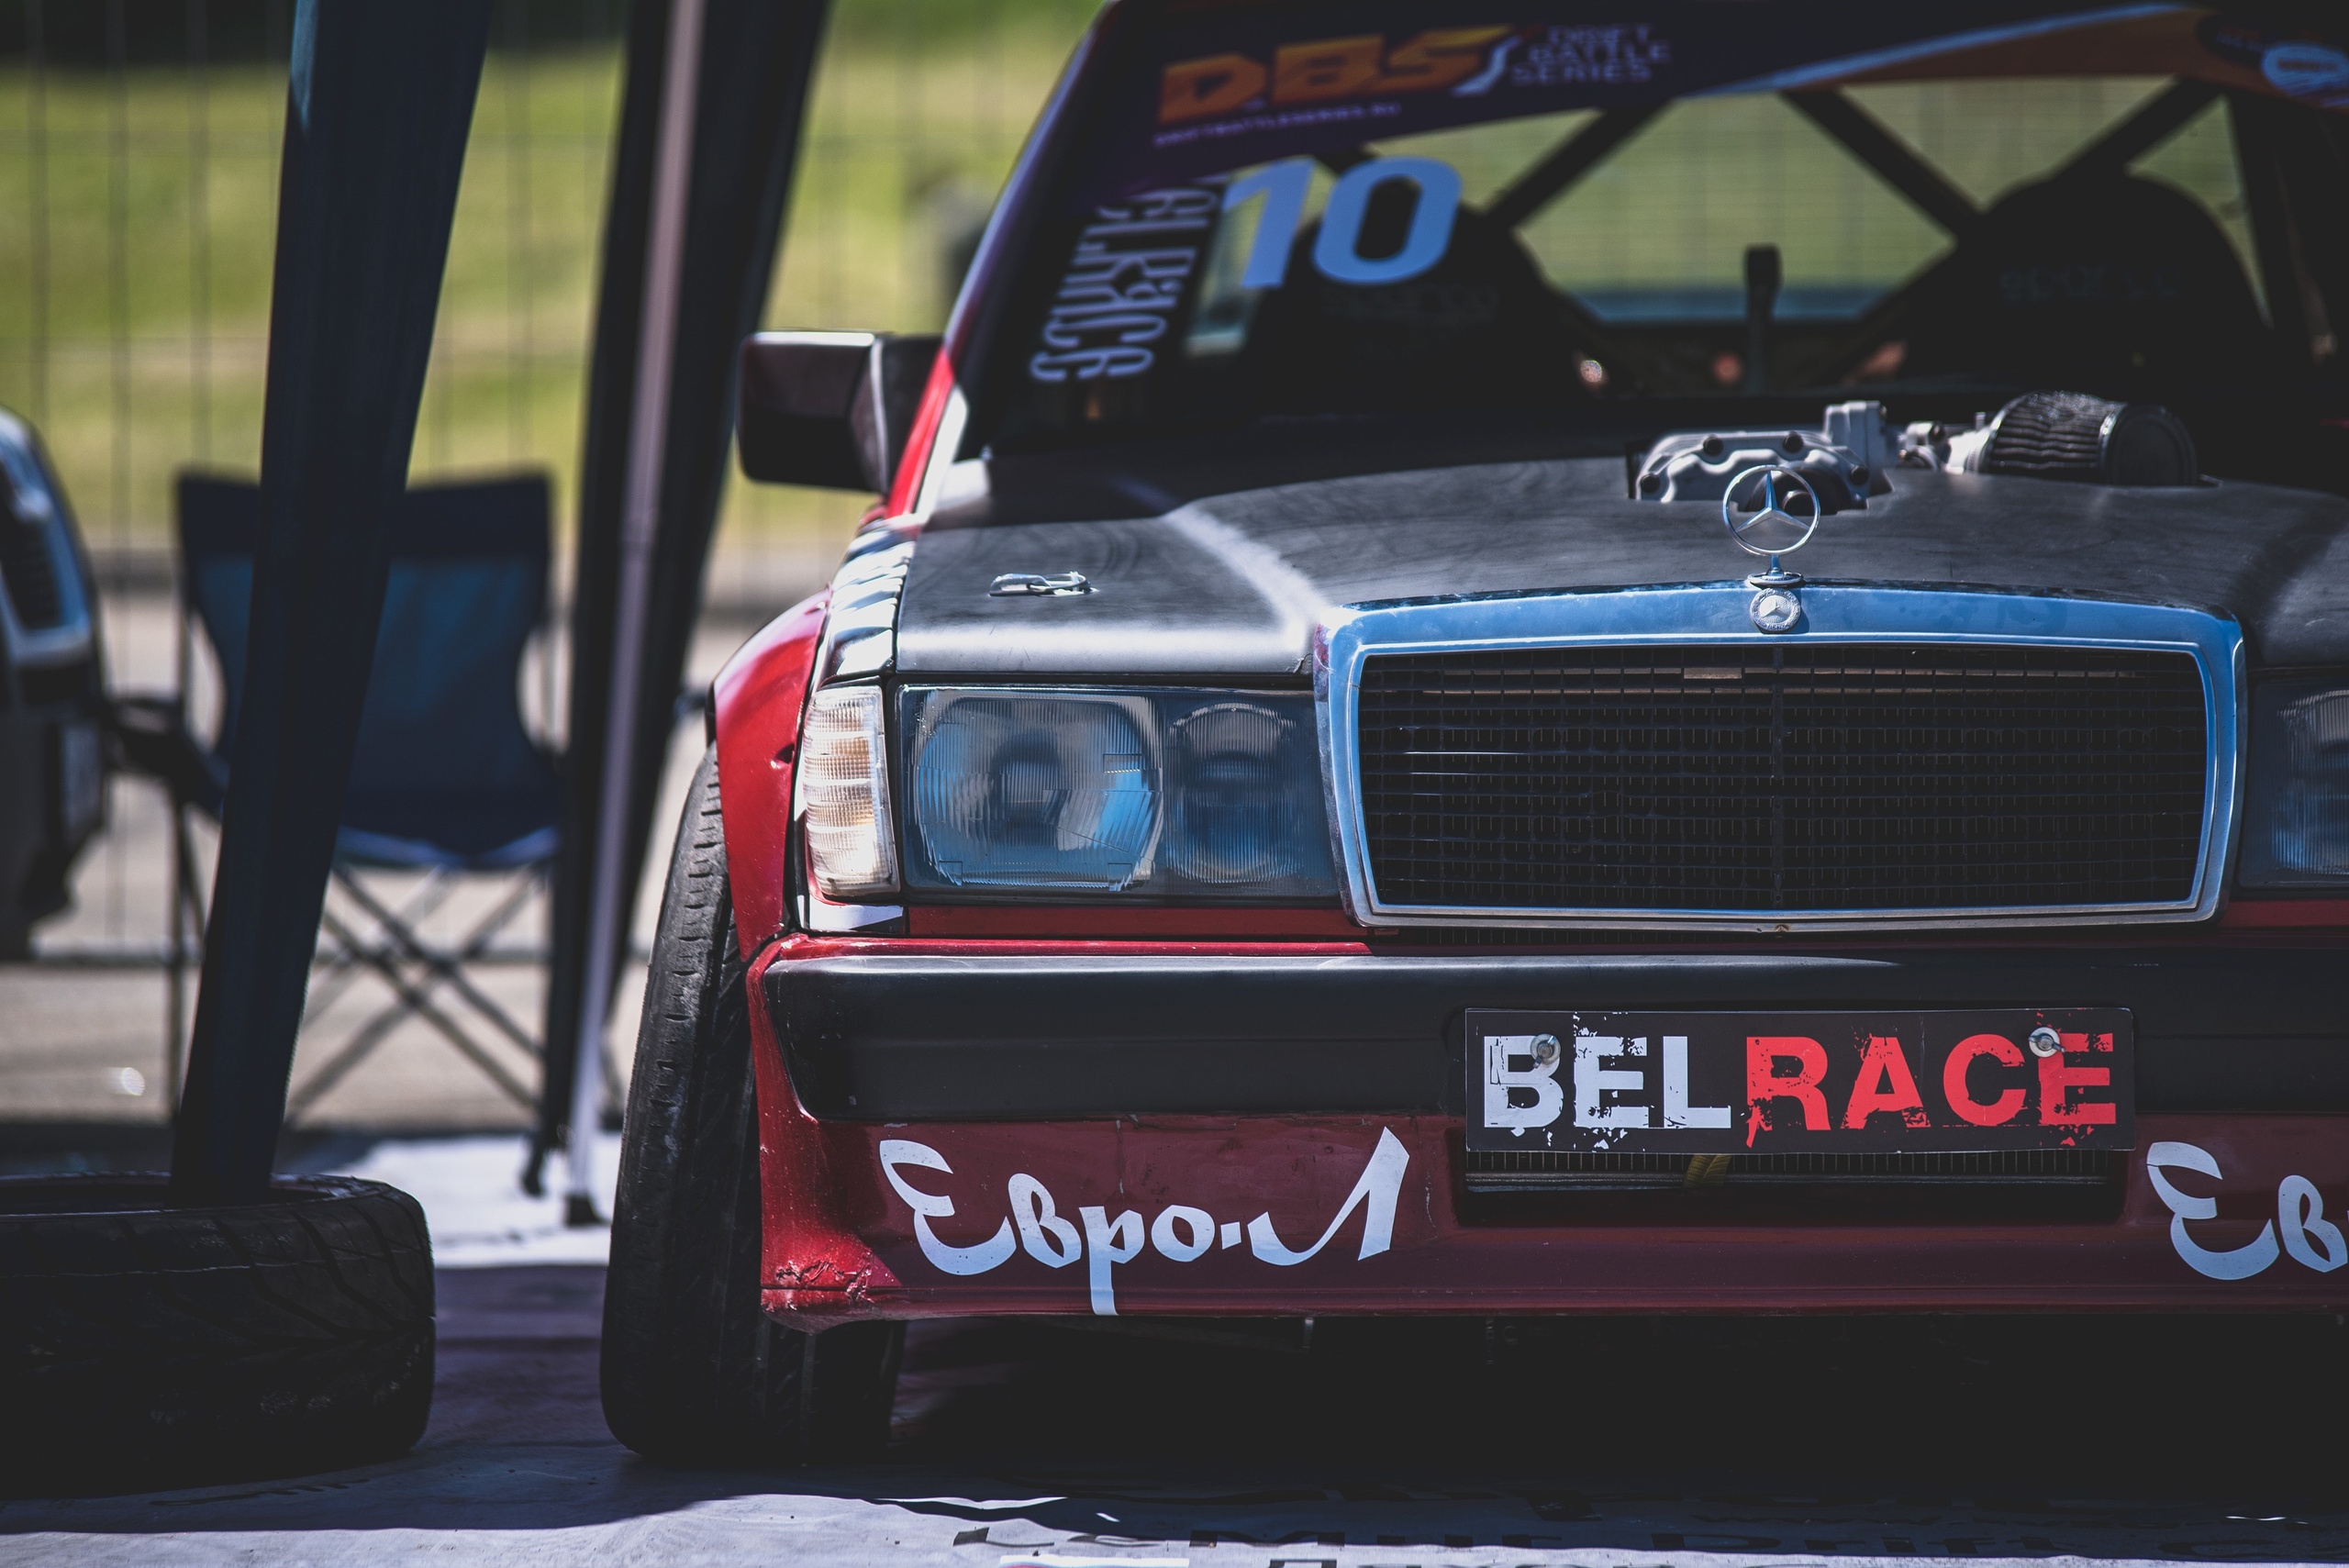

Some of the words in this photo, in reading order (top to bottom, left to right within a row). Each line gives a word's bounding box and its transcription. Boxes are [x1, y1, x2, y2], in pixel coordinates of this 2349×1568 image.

[1158, 23, 1516, 123] DBS
[1511, 62, 1652, 85] SERIES
[1528, 42, 1672, 63] BATTLE
[1548, 24, 1654, 44] DRIFT
[1221, 156, 1463, 288] 10
[1029, 186, 1220, 382] ELRACE
[2146, 1140, 2349, 1281] Ев
